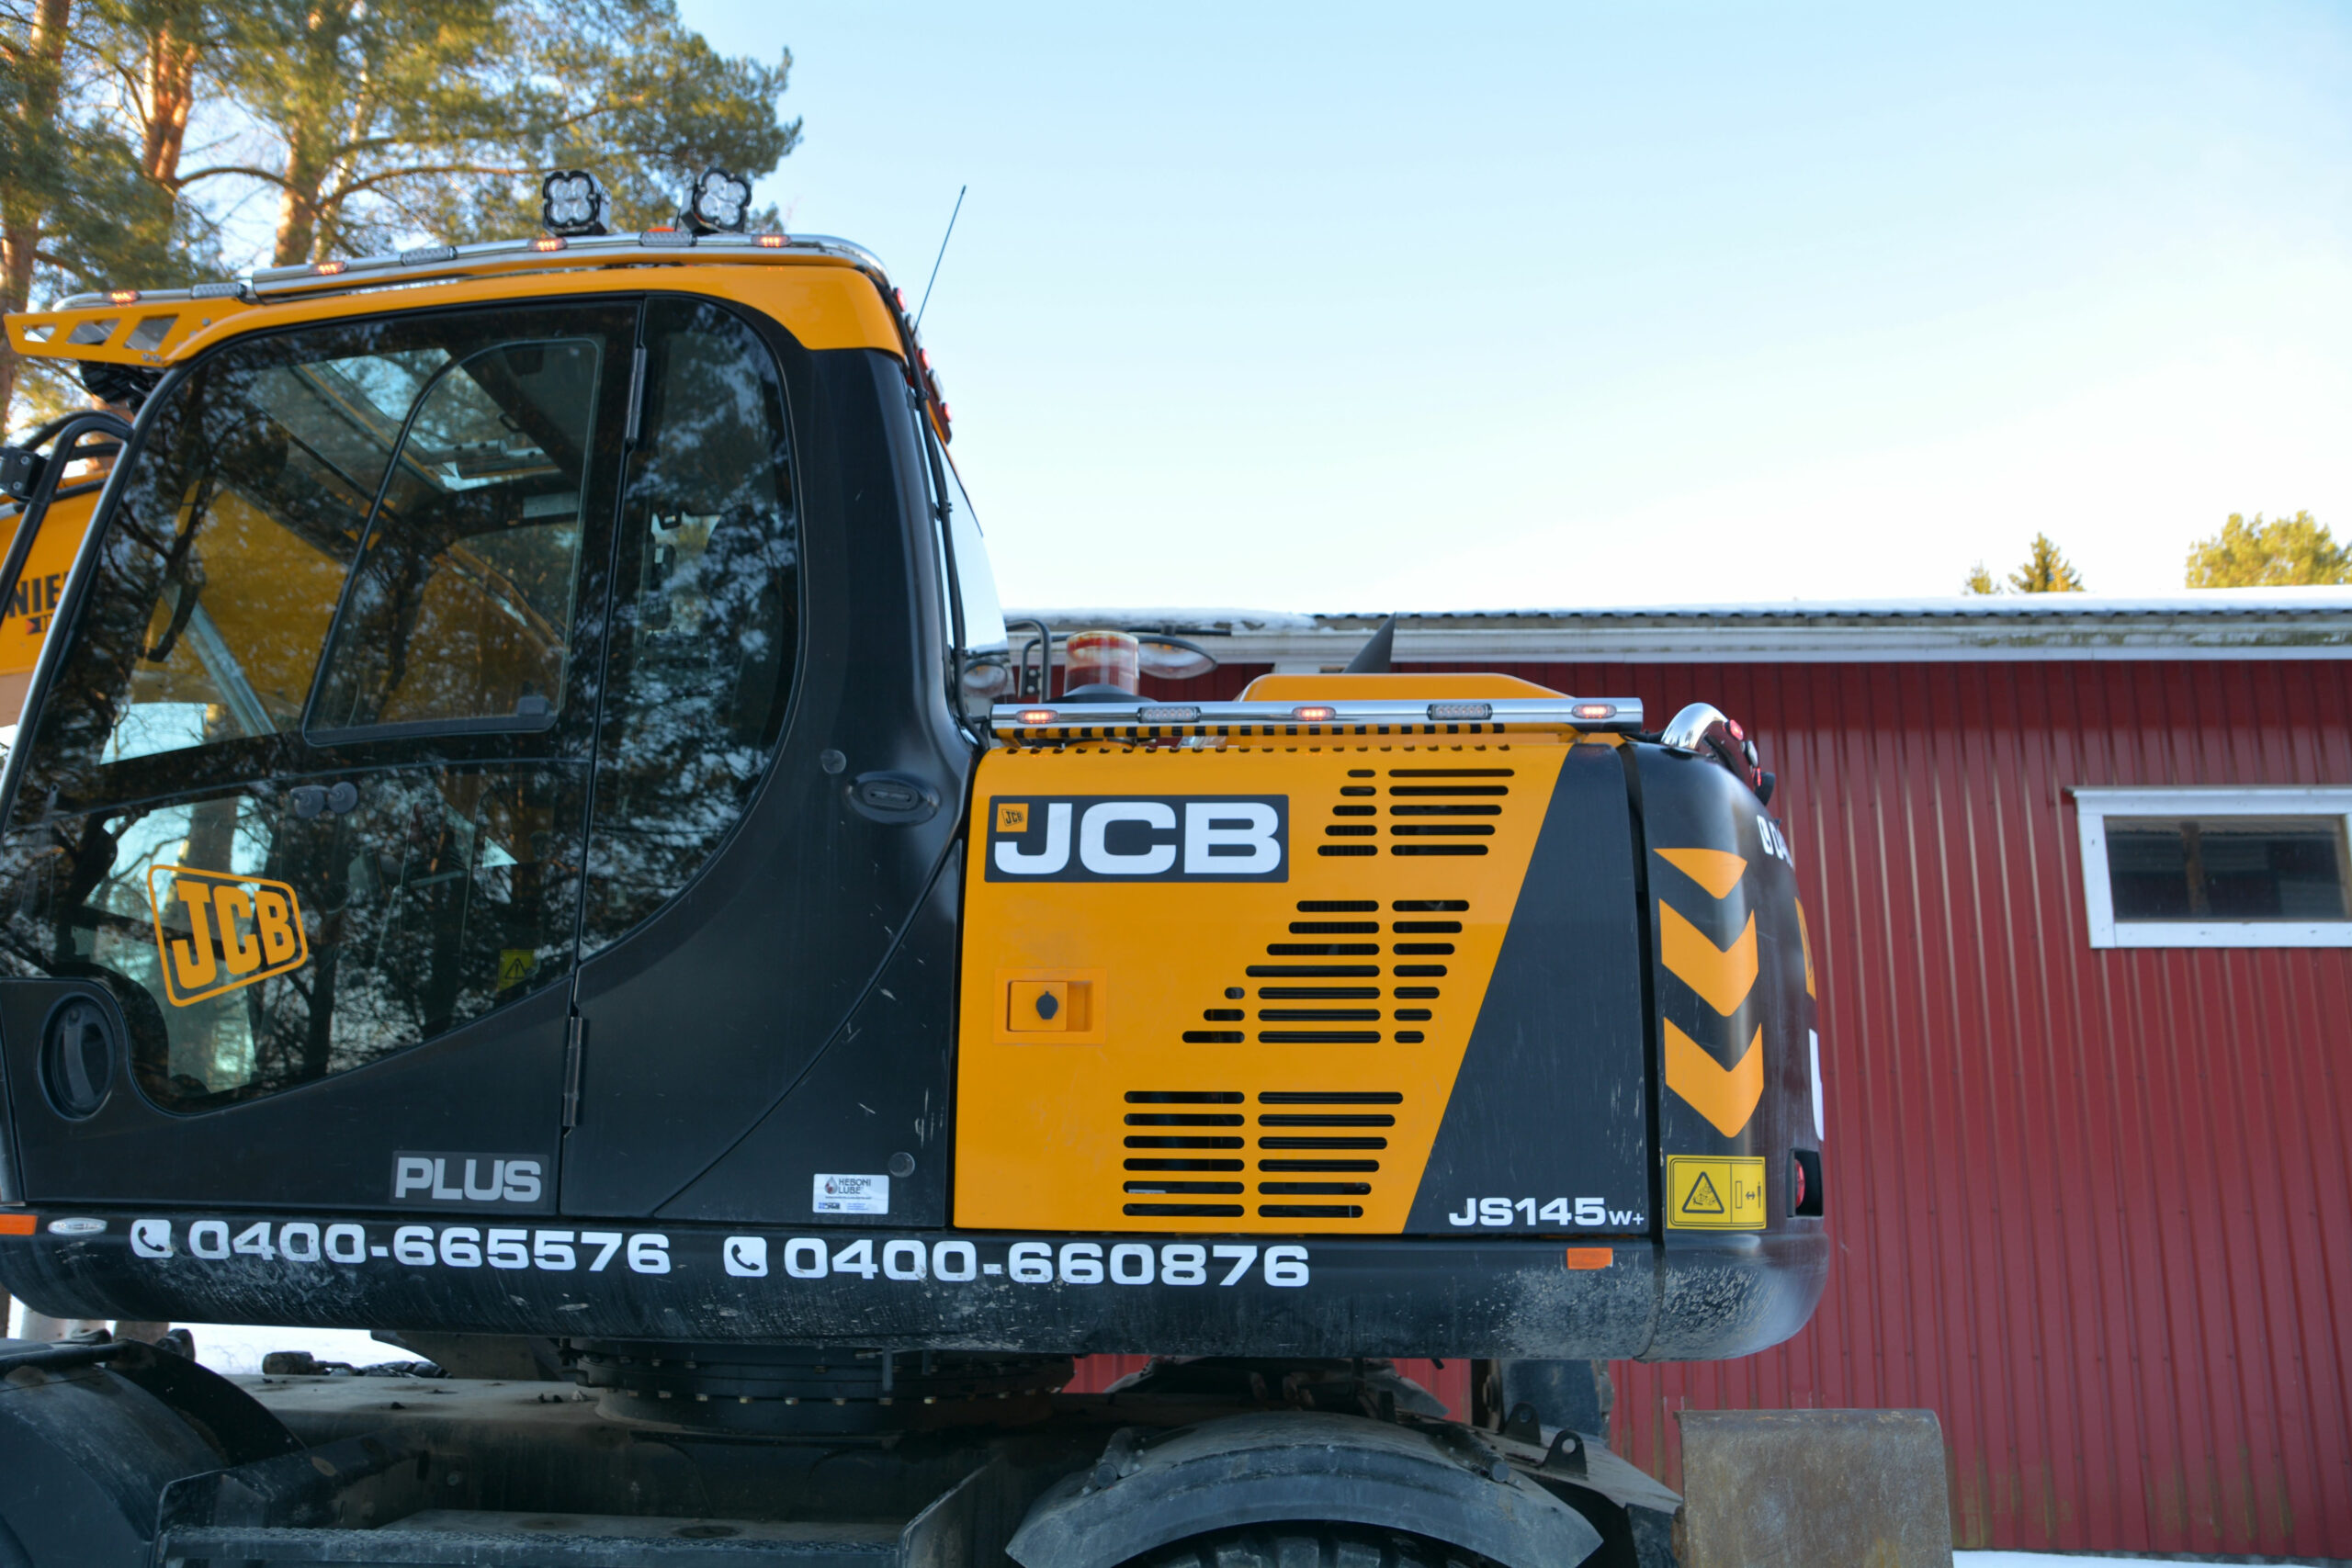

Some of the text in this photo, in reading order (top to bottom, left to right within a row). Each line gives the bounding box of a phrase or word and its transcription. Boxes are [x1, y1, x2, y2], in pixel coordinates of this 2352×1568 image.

[6, 571, 70, 618] NIE
[994, 802, 1281, 874] JCB
[1005, 810, 1023, 824] JCB
[171, 879, 296, 989] JCB
[395, 1157, 541, 1202] PLUS
[188, 1220, 672, 1274] 0400-665576
[784, 1237, 1310, 1287] 0400-660876
